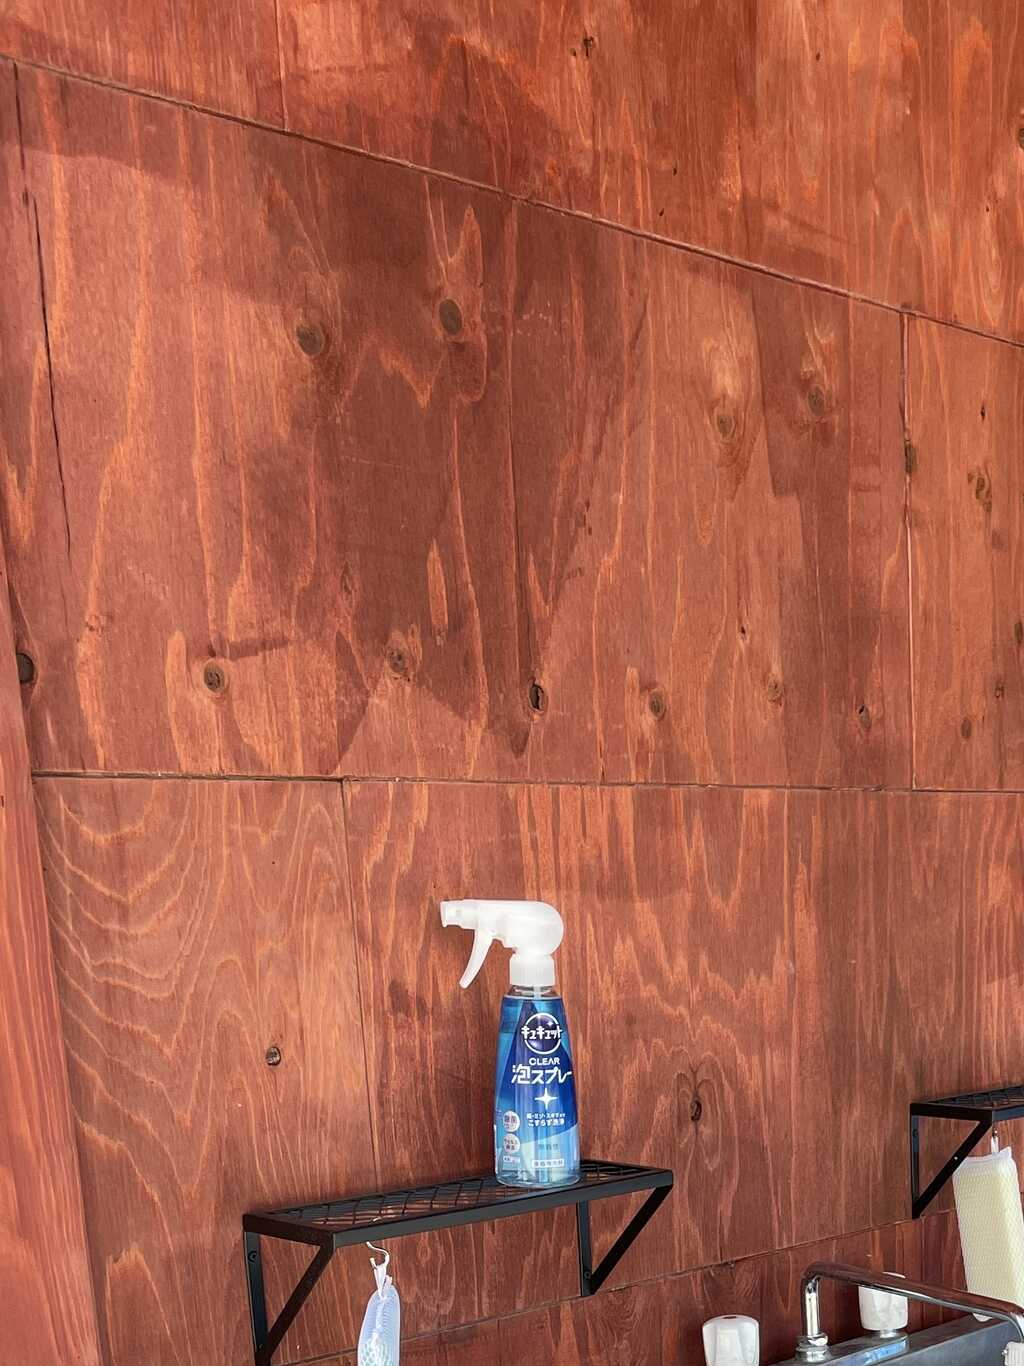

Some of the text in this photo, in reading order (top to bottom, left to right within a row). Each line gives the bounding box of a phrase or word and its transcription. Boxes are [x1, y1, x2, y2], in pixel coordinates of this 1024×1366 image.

[521, 1025, 563, 1040] キュキュット
[528, 1057, 561, 1066] CLEAR
[511, 1063, 573, 1085] 泡スプレー
